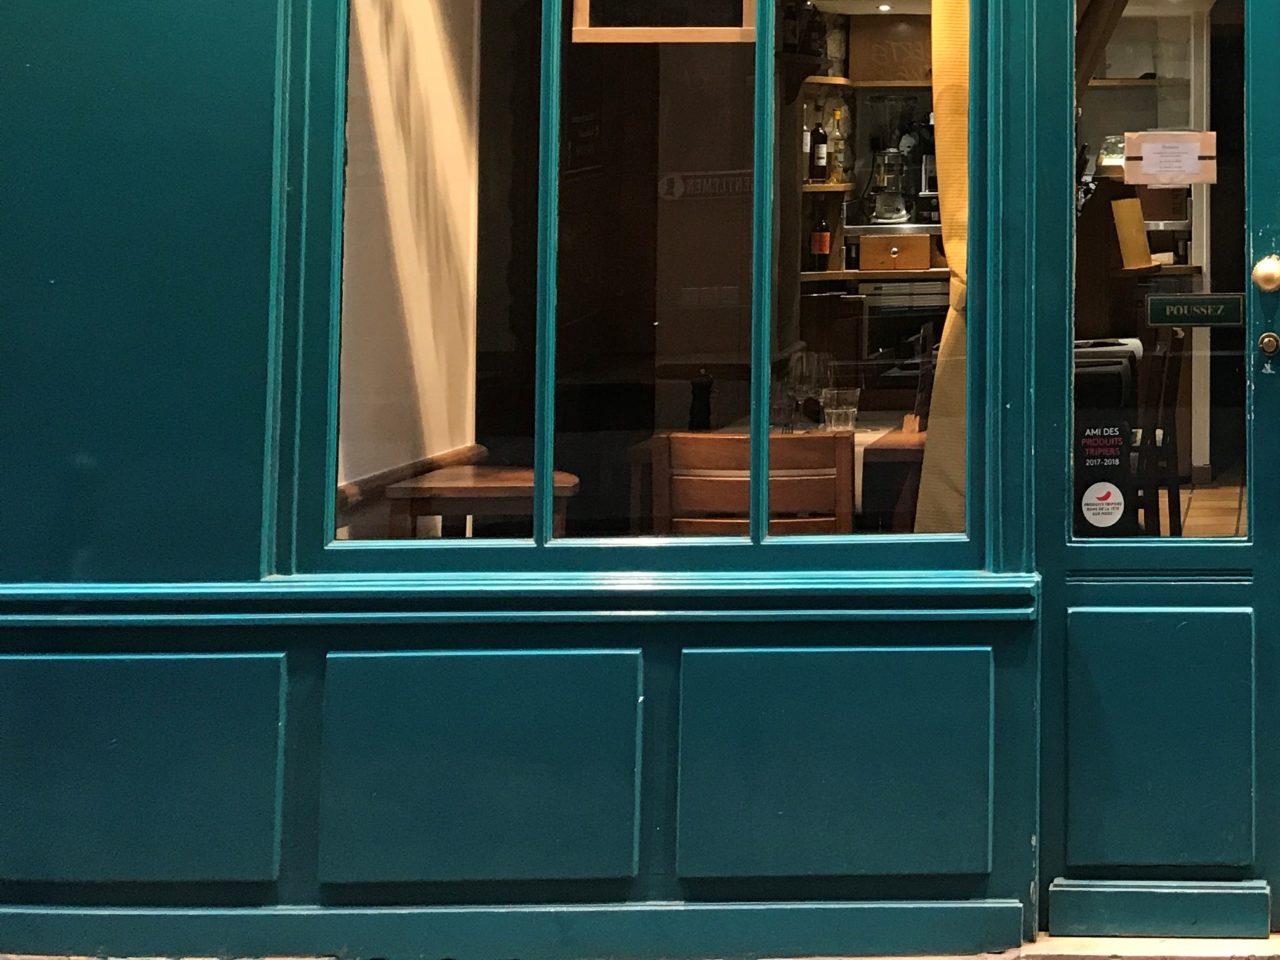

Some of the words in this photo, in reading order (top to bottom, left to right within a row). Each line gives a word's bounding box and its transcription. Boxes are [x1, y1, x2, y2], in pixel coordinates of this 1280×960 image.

[1165, 305, 1224, 316] POUSSEZ
[1085, 428, 1101, 436] AMI
[1103, 427, 1119, 436] DES
